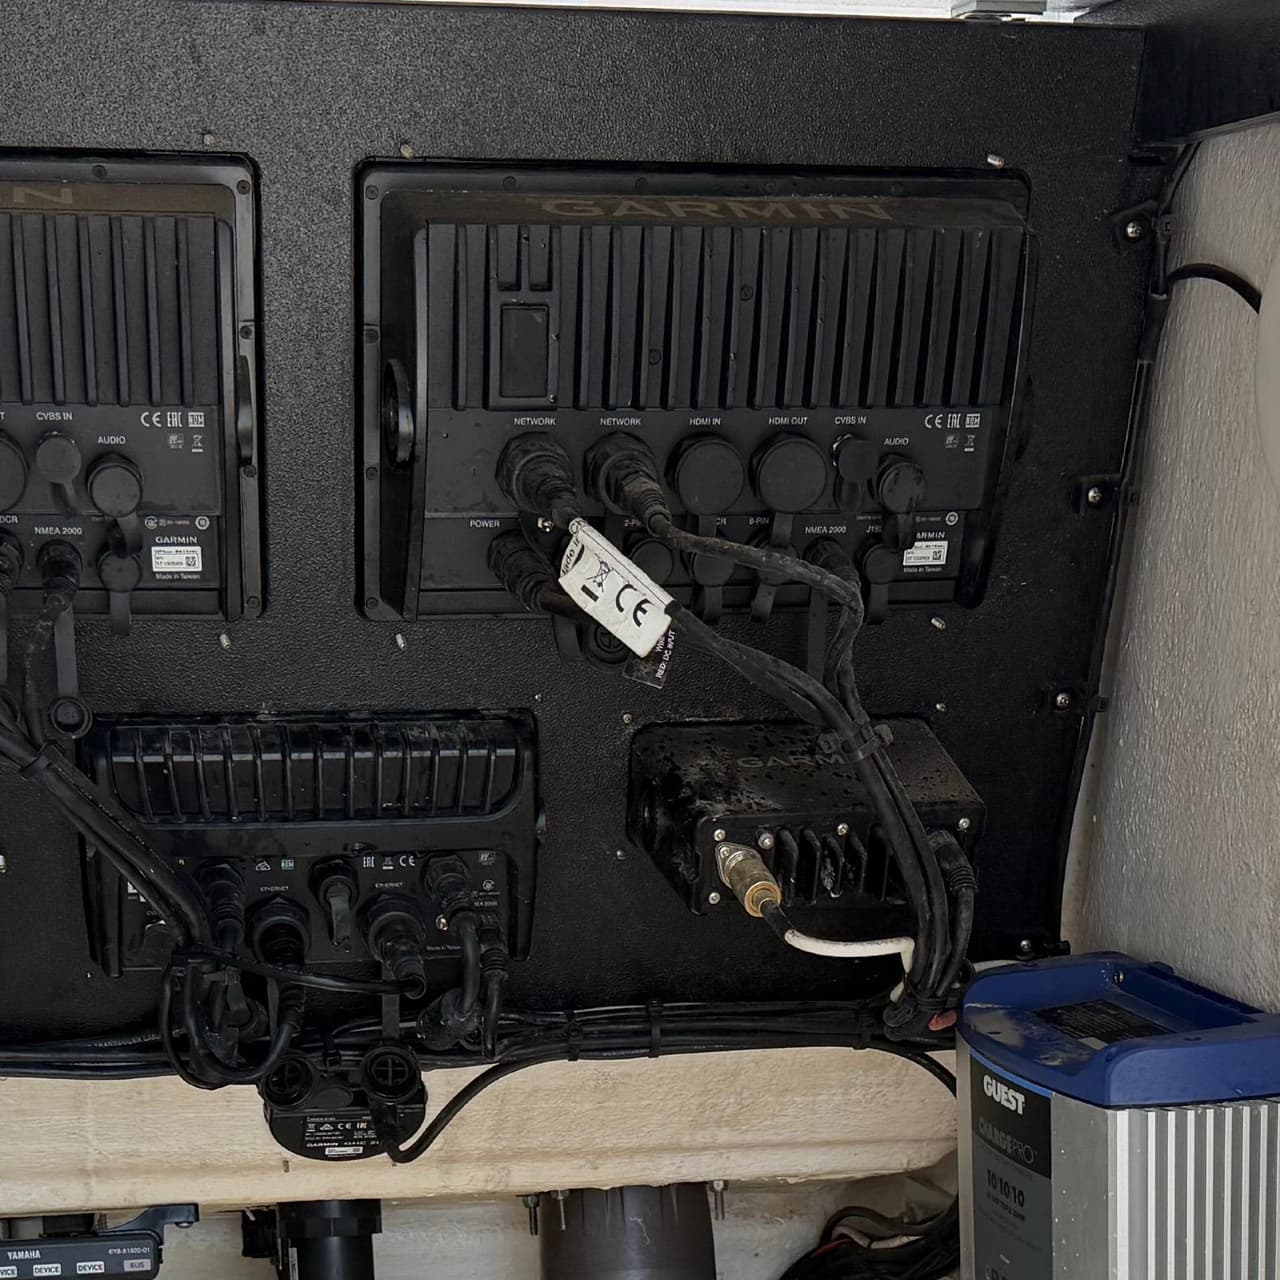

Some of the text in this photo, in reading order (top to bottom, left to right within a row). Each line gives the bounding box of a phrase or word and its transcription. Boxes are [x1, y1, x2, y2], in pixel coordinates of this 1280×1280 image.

[540, 199, 893, 220] GARMIN
[36, 411, 73, 421] CVBS IN
[768, 416, 808, 425] HDMI OUT
[834, 416, 867, 425] CVBS IN
[513, 417, 557, 426] NETWORK
[600, 417, 641, 426] NETWORK
[689, 417, 721, 426] HDMI IN
[97, 435, 126, 445] AUDIO
[883, 437, 909, 446] AUDIO
[469, 519, 500, 528] POWER
[34, 526, 83, 535] NMEA 2000
[805, 525, 847, 534] NMEA 2000
[155, 535, 198, 544] GARMIN
[915, 531, 946, 539] ARMIN
[737, 754, 846, 768] GARM
[983, 1074, 1026, 1115] GUEST
[978, 1116, 1035, 1165] CHARGEPRO
[987, 1169, 997, 1190] 10
[999, 1177, 1010, 1198] 10
[1012, 1188, 1025, 1208] 10
[7, 1249, 41, 1261] YAMAHA
[76, 1262, 104, 1273] DEVICE
[129, 1260, 145, 1269] BUS
[34, 1264, 60, 1275] DEVICE
